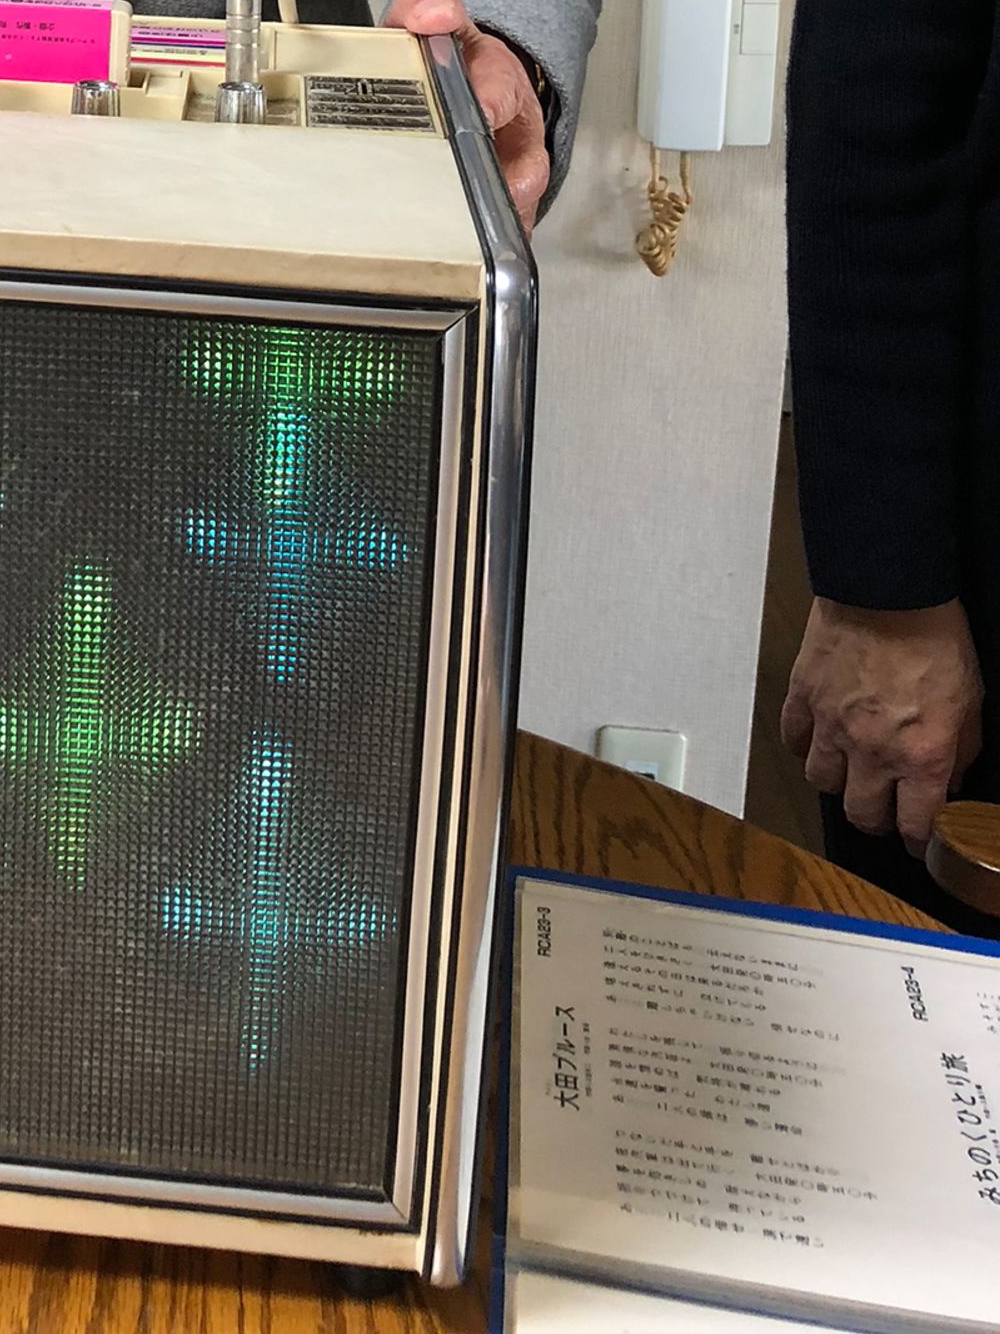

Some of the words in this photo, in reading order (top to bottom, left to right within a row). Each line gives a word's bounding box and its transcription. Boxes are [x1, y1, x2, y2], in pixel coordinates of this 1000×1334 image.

[537, 906, 551, 957] RCA23-3
[901, 965, 929, 1022] RCA23-4
[555, 1005, 580, 1111] 大田ブルース
[940, 1052, 1000, 1204] みちのくひとり旅
